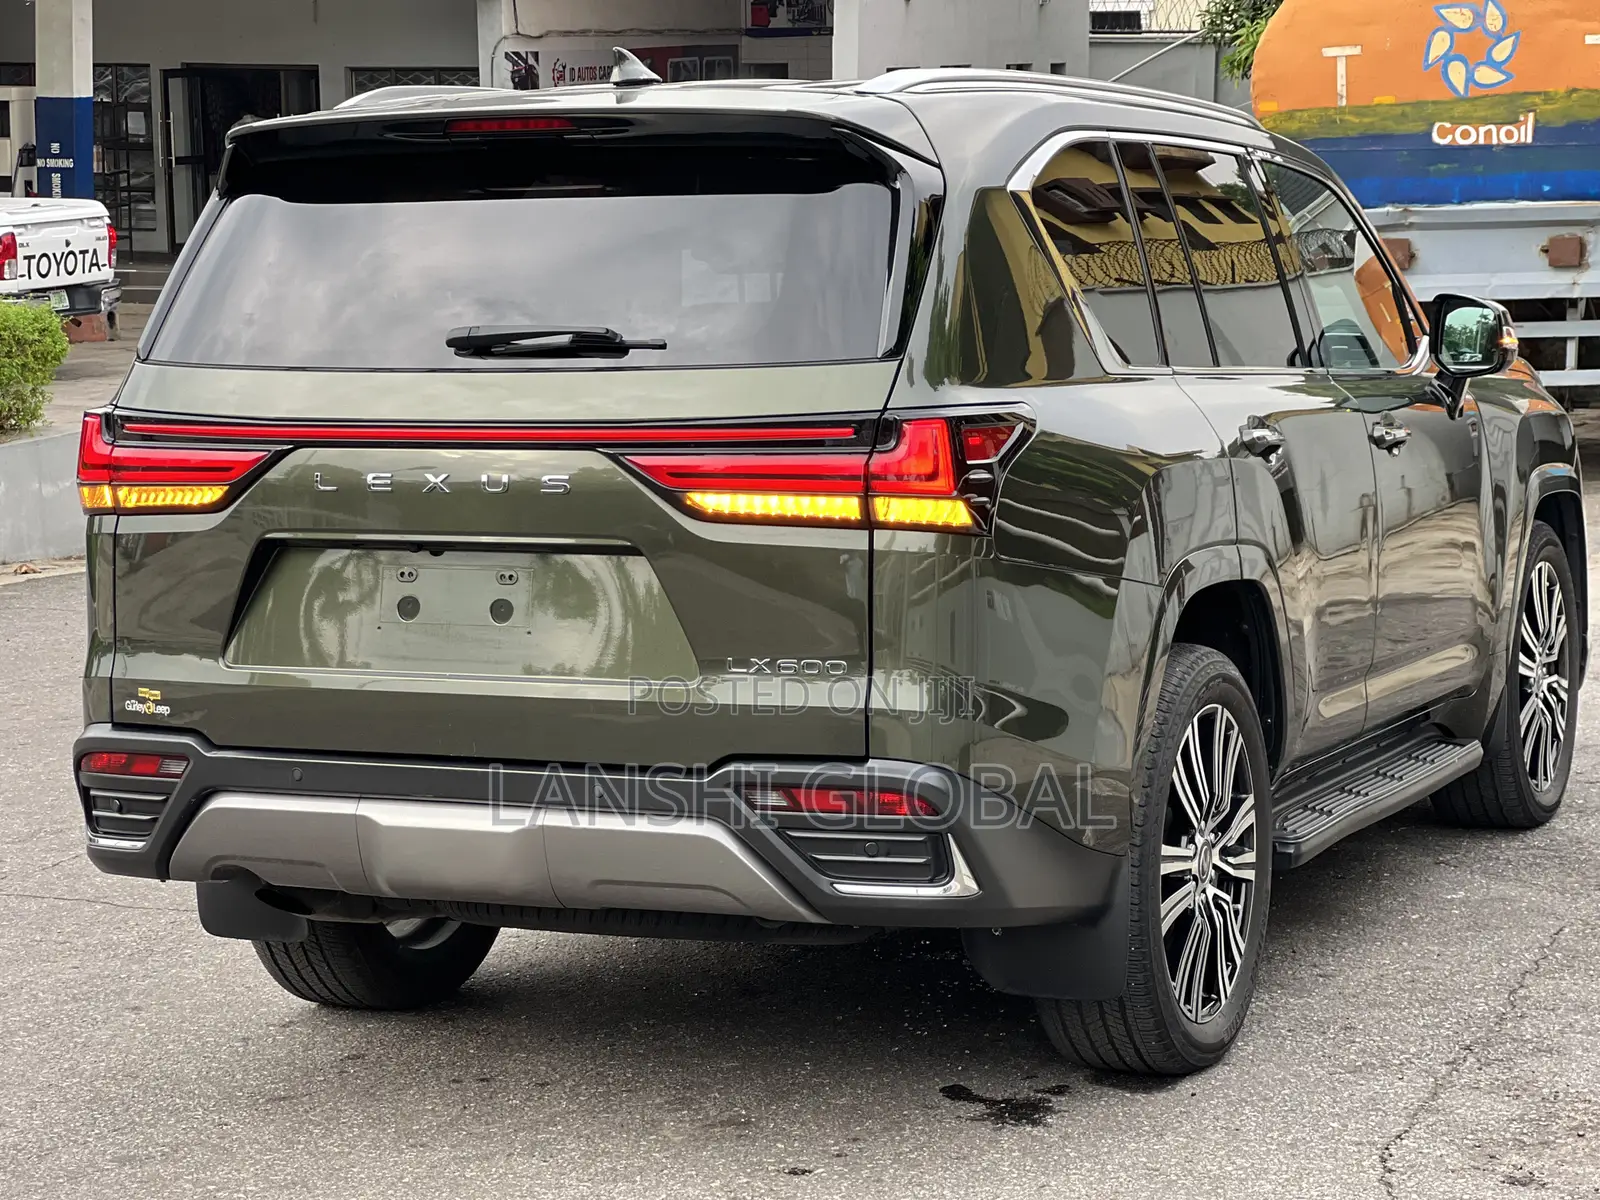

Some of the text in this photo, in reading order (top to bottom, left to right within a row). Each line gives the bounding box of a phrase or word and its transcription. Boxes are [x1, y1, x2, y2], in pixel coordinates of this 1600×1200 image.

[577, 66, 597, 82] AUTOS
[1432, 112, 1535, 145] Conoil
[51, 143, 60, 153] NO
[37, 158, 74, 168] NO SMOKING
[23, 248, 101, 279] TOYOTA
[314, 472, 572, 494] LEXUS
